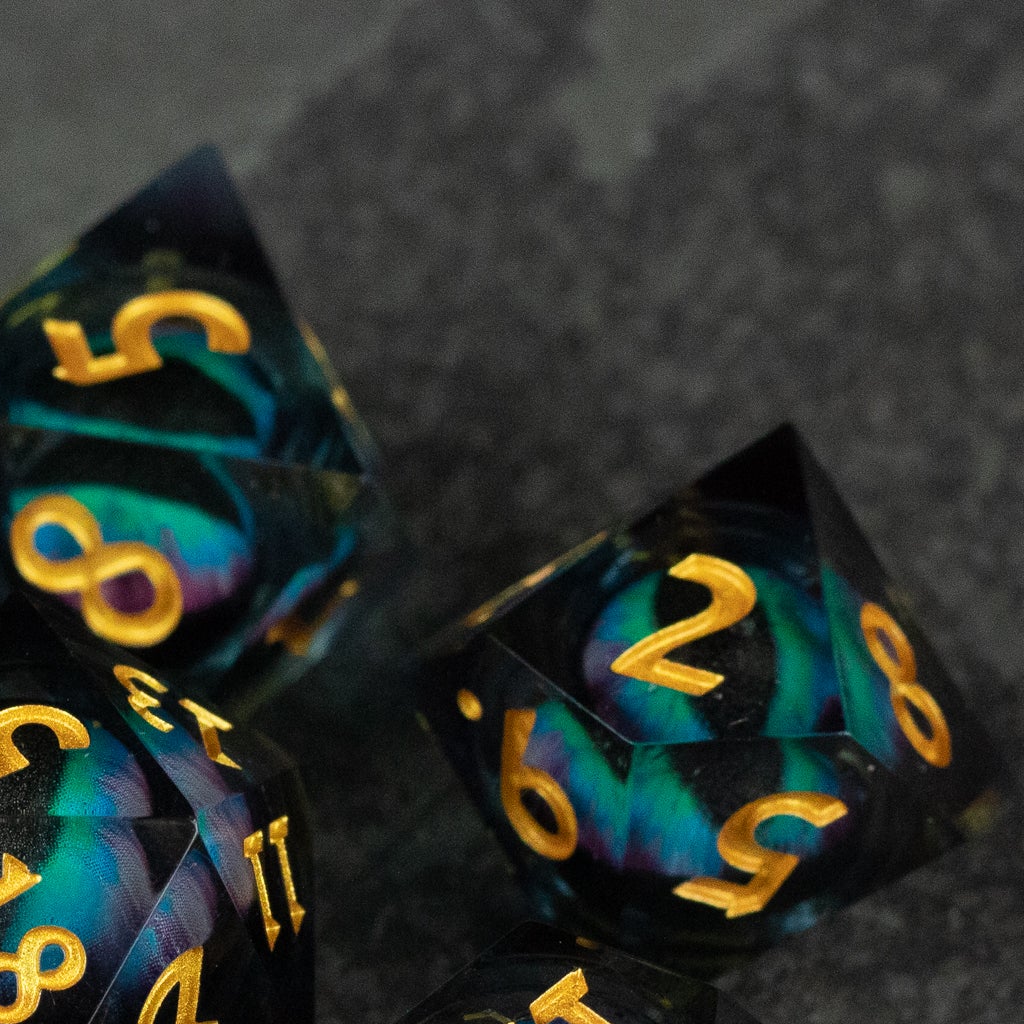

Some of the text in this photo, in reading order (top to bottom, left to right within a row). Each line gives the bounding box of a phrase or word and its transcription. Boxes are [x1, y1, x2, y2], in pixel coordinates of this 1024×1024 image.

[42, 289, 251, 387] 5
[10, 494, 184, 648] 8
[609, 552, 757, 697] 2
[112, 663, 243, 771] 13
[859, 602, 952, 769] 8
[672, 791, 849, 920] 5
